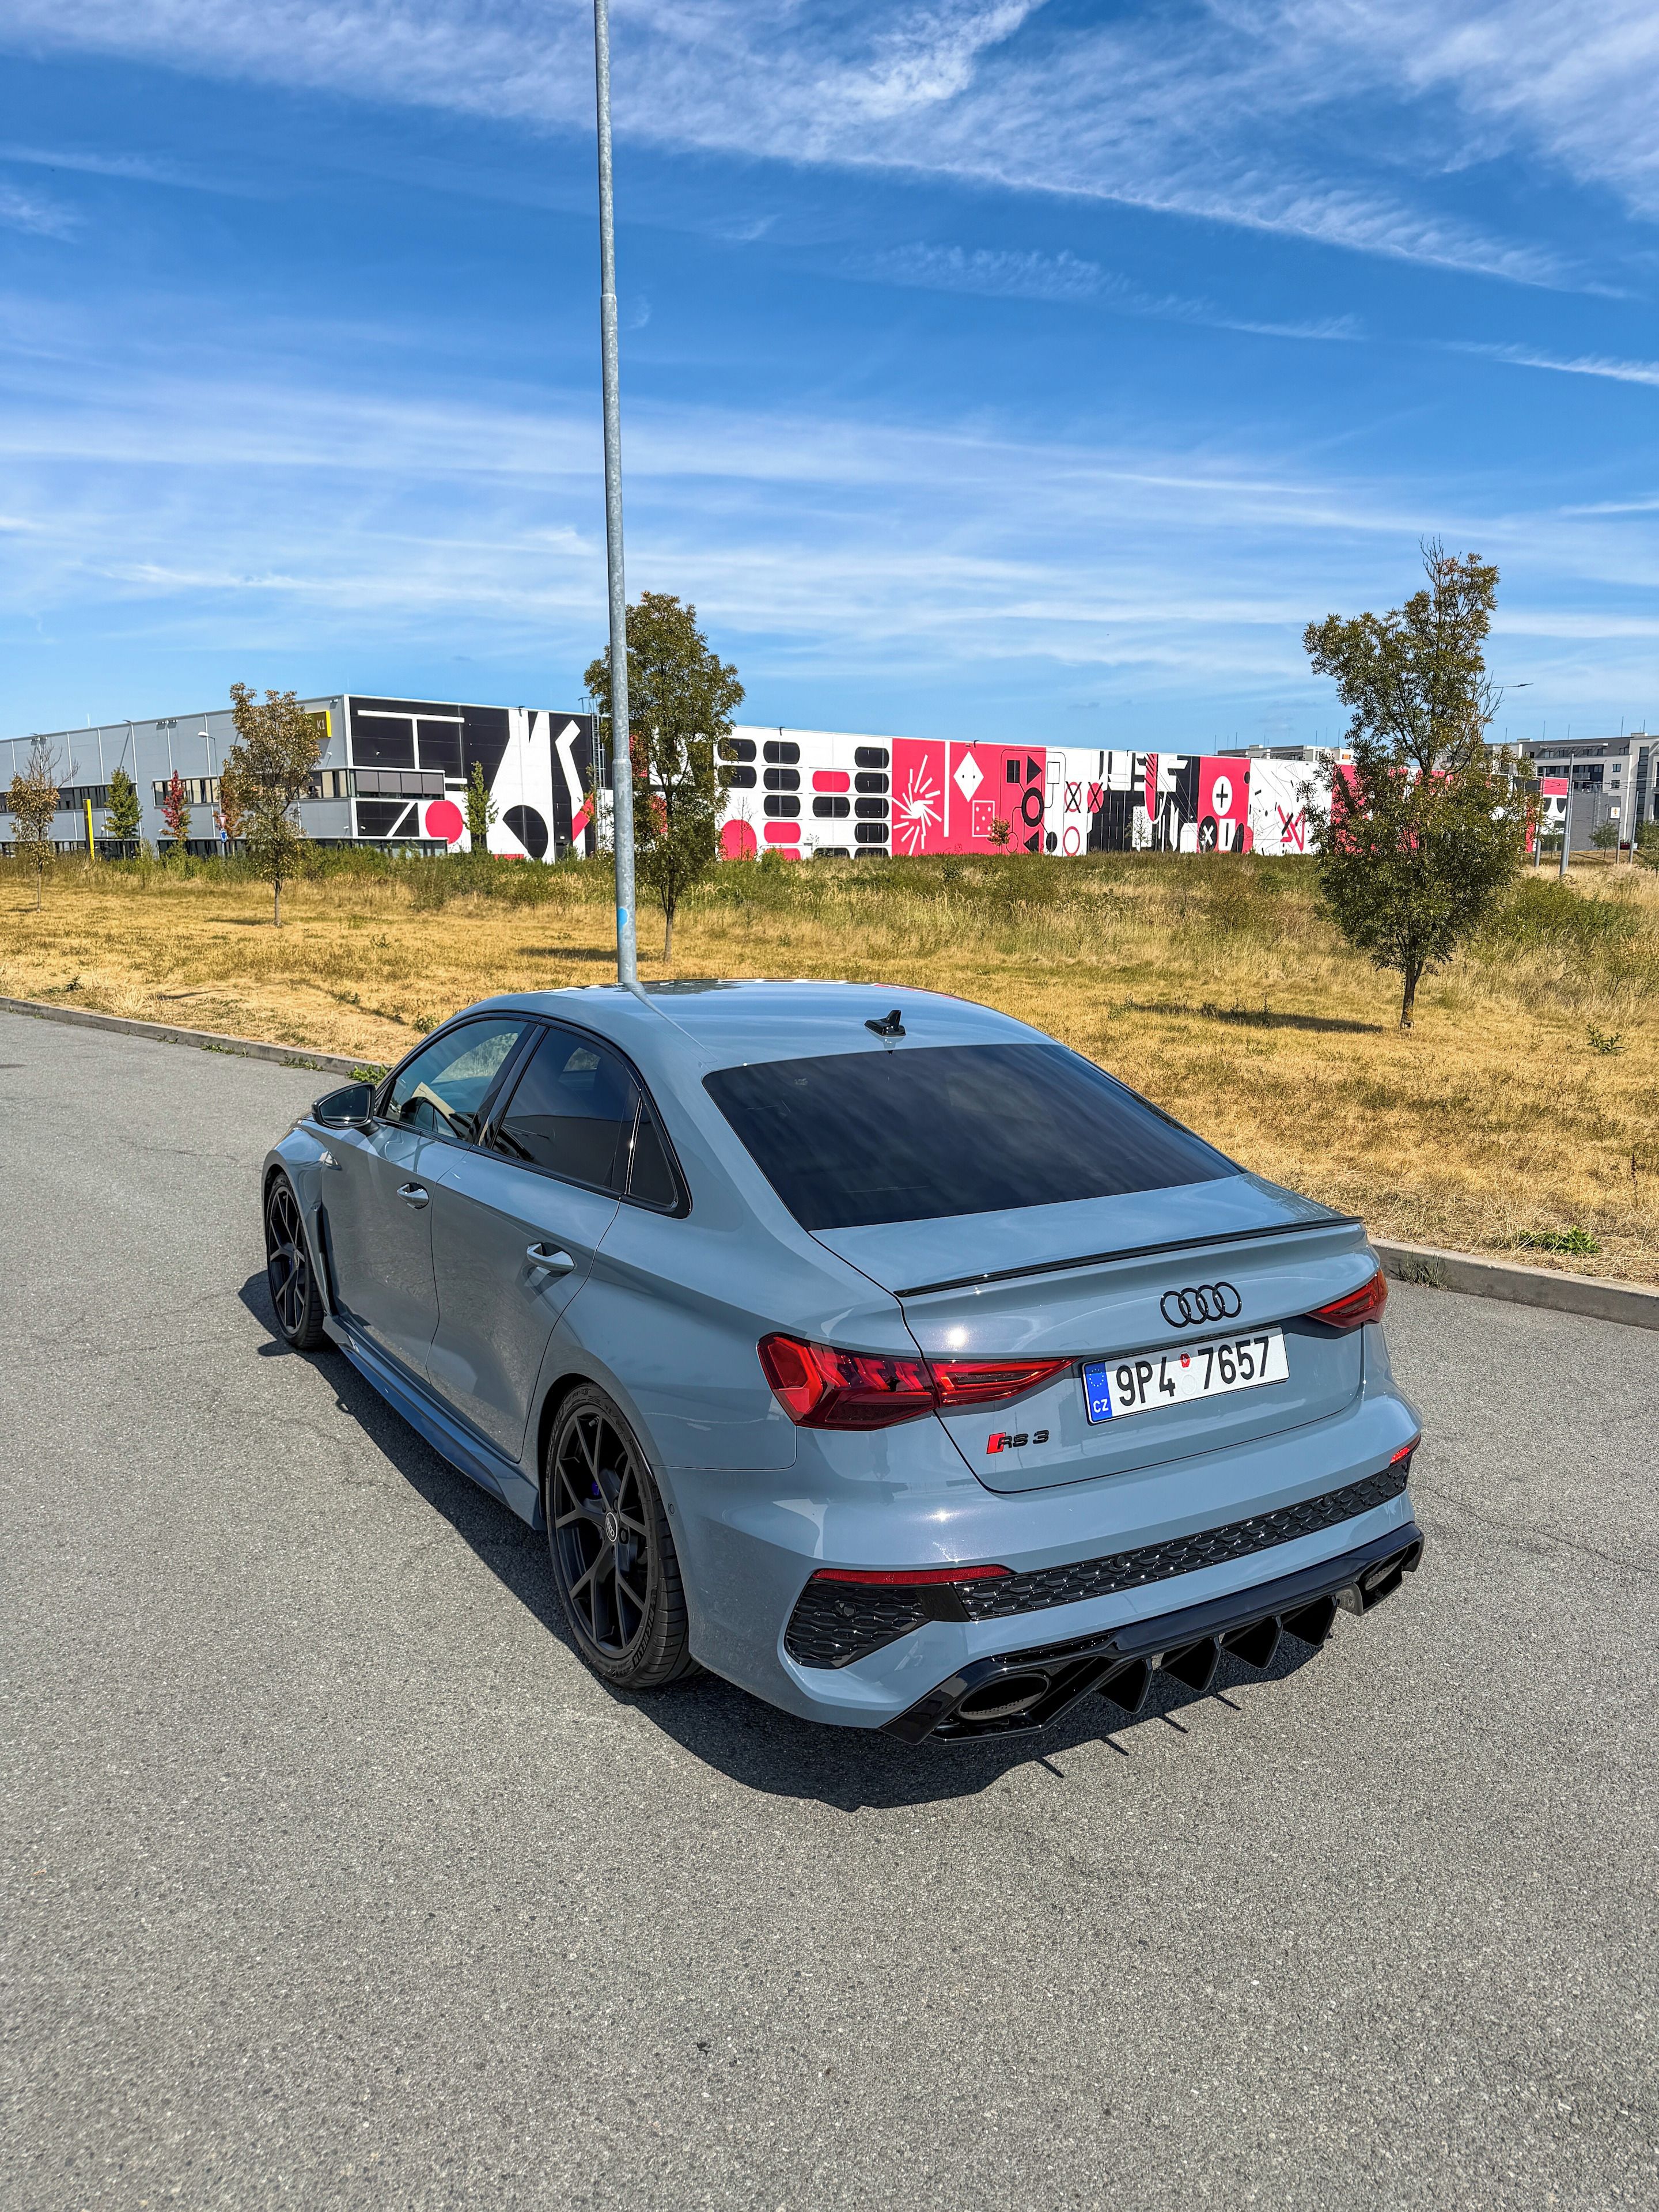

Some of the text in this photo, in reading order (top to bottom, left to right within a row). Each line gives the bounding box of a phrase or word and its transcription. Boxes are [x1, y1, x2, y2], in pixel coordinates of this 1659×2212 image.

[317, 719, 325, 730] K1
[1116, 1336, 1269, 1406] 9P4 7657
[1093, 1399, 1109, 1413] CZ
[995, 1430, 1049, 1449] RS 3
[633, 1608, 654, 1666] MICHELIN
